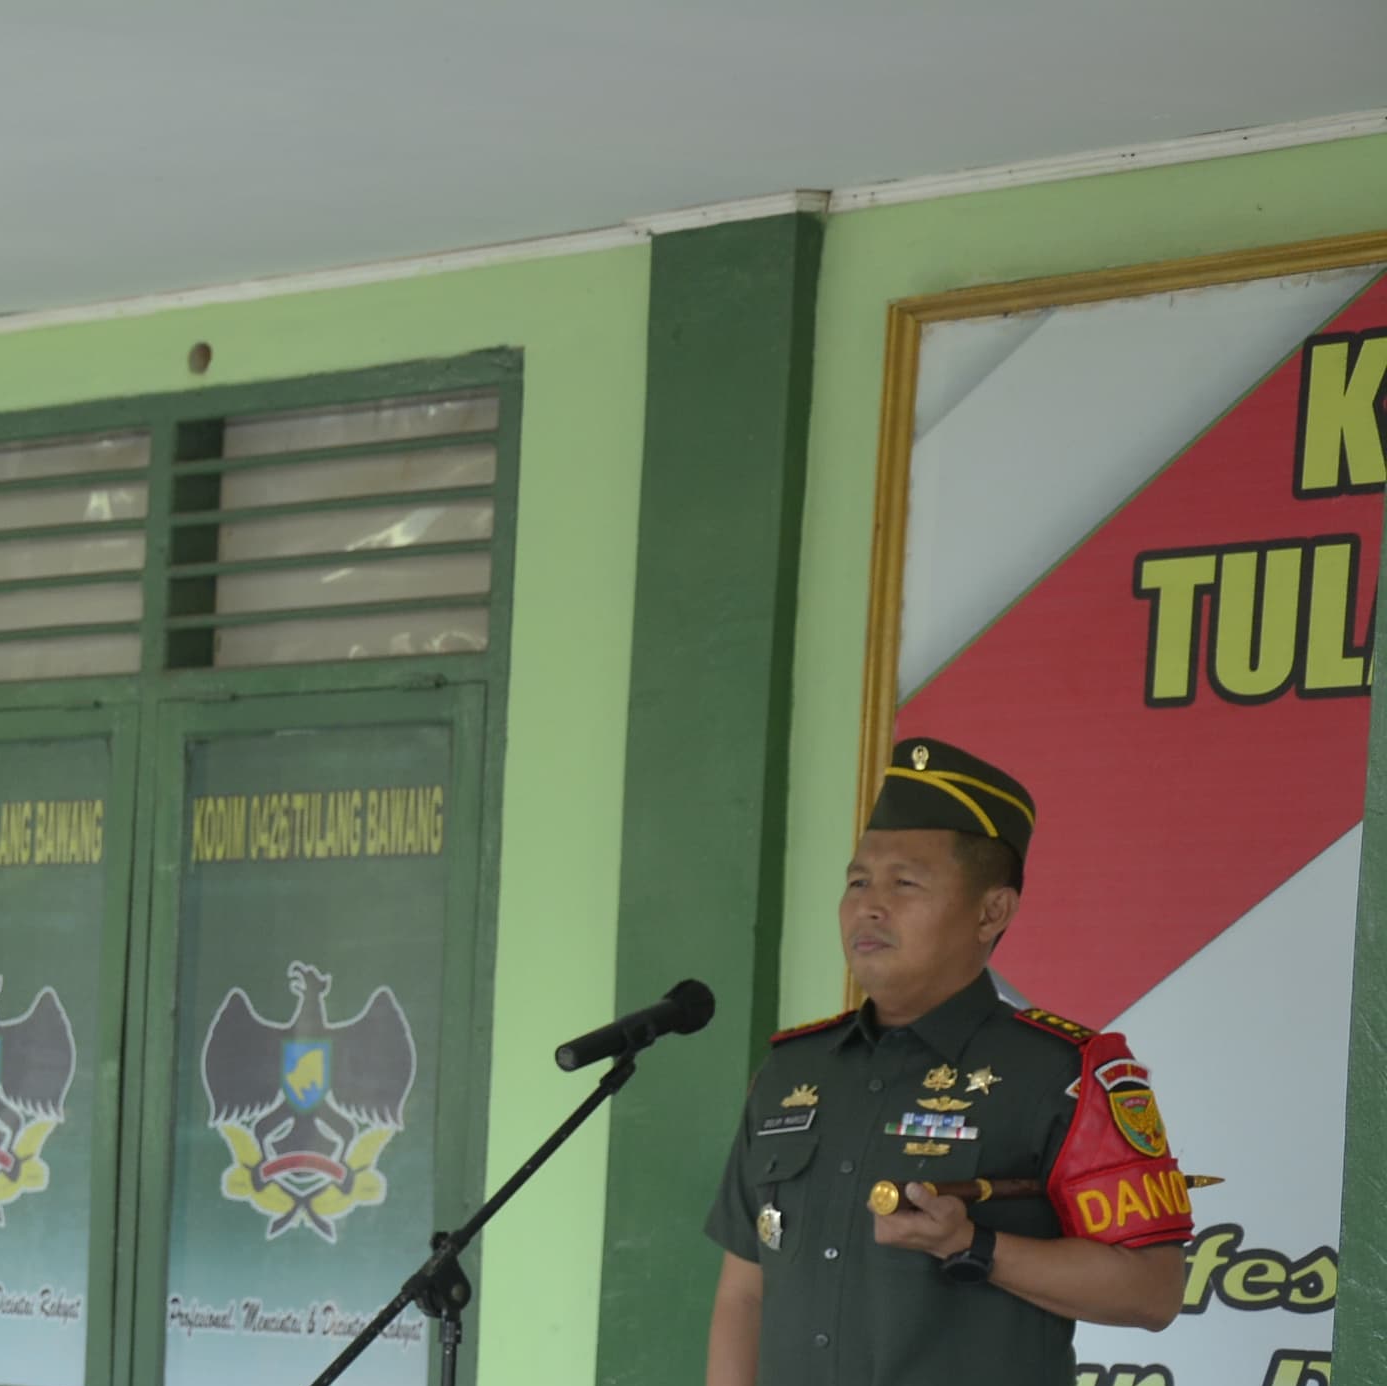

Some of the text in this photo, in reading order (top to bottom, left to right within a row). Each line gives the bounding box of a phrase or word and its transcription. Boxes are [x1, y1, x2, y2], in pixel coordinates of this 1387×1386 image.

[1134, 533, 1375, 706] TUL
[34, 799, 103, 864] BAWANG
[291, 789, 362, 859] TULANG
[365, 785, 444, 855] BAWANG
